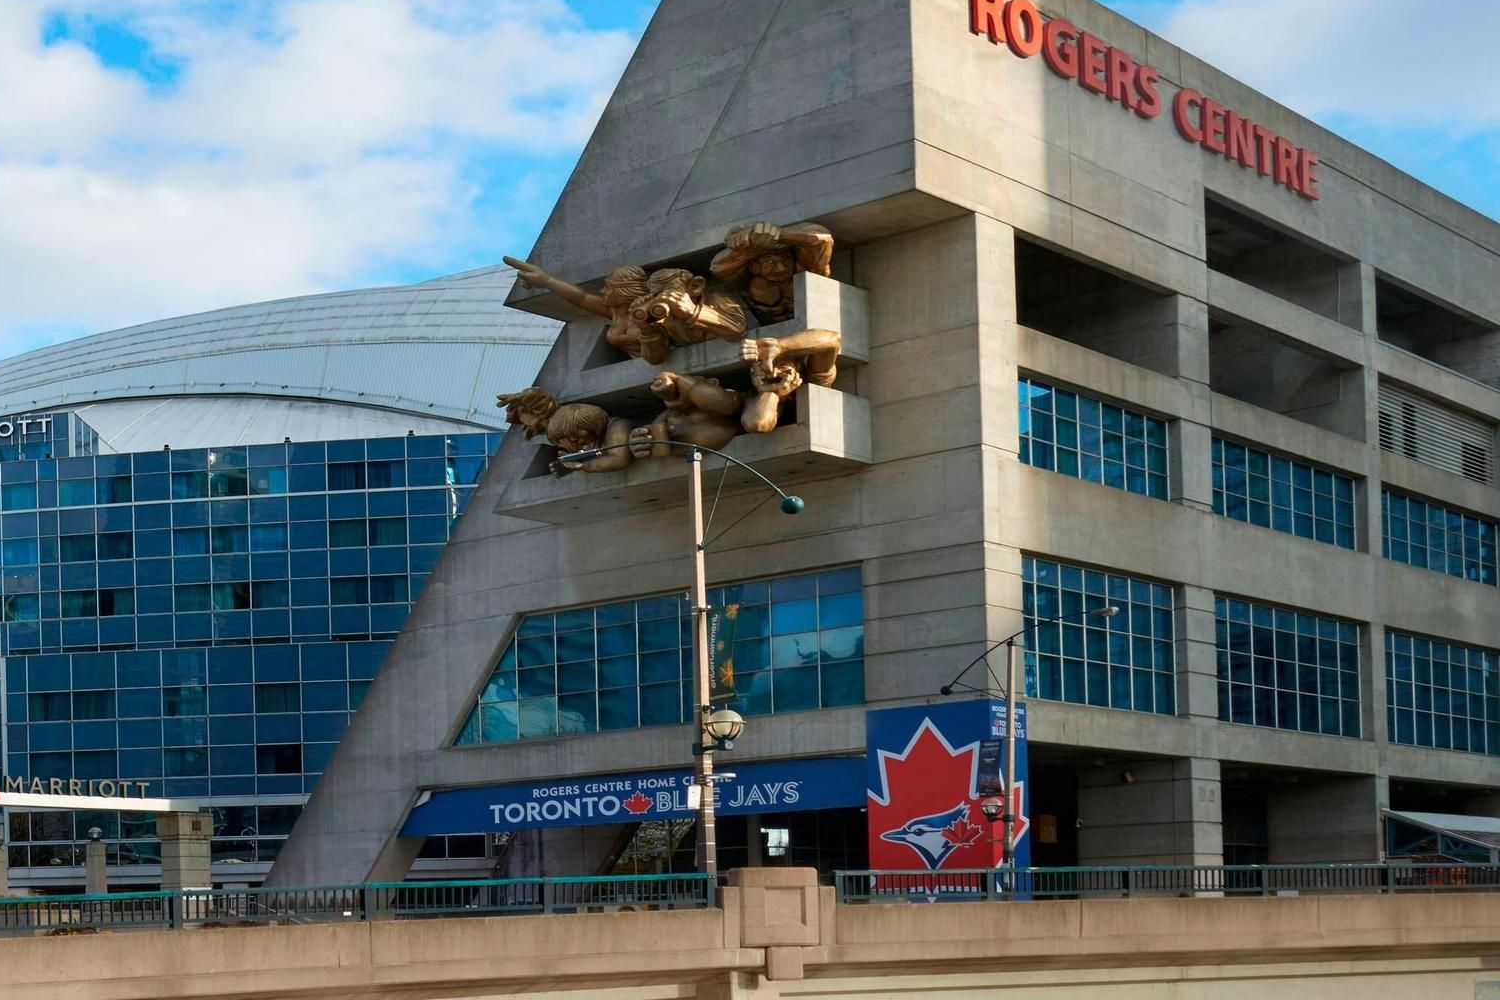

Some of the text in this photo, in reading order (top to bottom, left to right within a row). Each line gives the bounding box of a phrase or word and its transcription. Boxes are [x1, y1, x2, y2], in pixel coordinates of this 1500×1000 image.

[1173, 87, 1321, 201] CENTRE
[5, 775, 150, 799] MARRIOTT
[489, 781, 800, 824] TORONTO BLE JAYS
[533, 785, 580, 798] ROGERS
[584, 780, 632, 794] CENTRE
[638, 776, 676, 790] HOME
